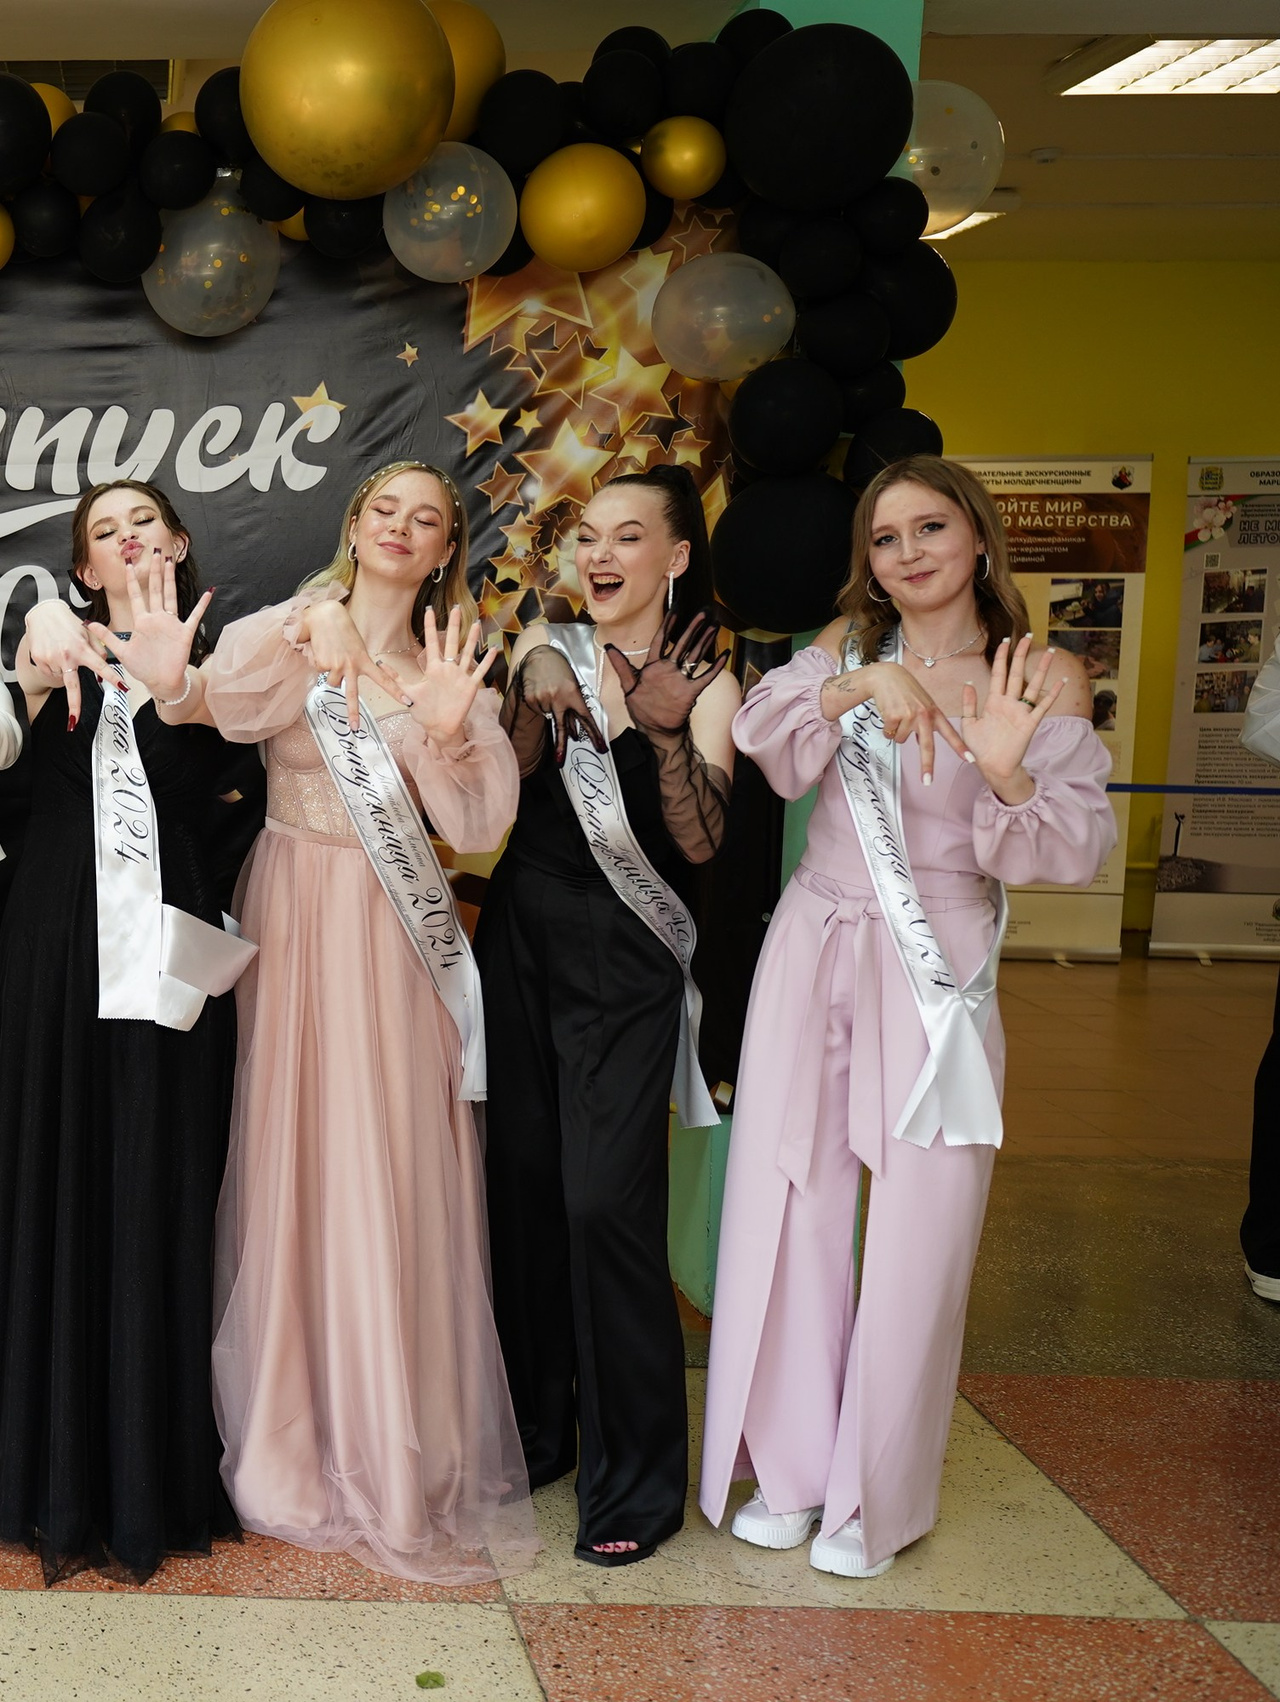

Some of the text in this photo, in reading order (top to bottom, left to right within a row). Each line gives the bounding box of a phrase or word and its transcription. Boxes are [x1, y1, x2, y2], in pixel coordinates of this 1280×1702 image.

[1024, 469, 1092, 477] ЭКСКУРСИОННЫЕ
[1249, 470, 1280, 478] ОБРАЗО
[1003, 478, 1082, 486] МОЛОДЕЧНЕНЩИНЫ
[996, 498, 1084, 514] ОЙТЕ МИР
[1018, 514, 1132, 527] МАСТЕРСТВА
[1239, 520, 1260, 531] НЕ
[1238, 532, 1280, 544] ЛЕТО
[110, 759, 150, 865] 2024
[315, 690, 419, 885] Выпускница
[406, 886, 464, 972] 2024
